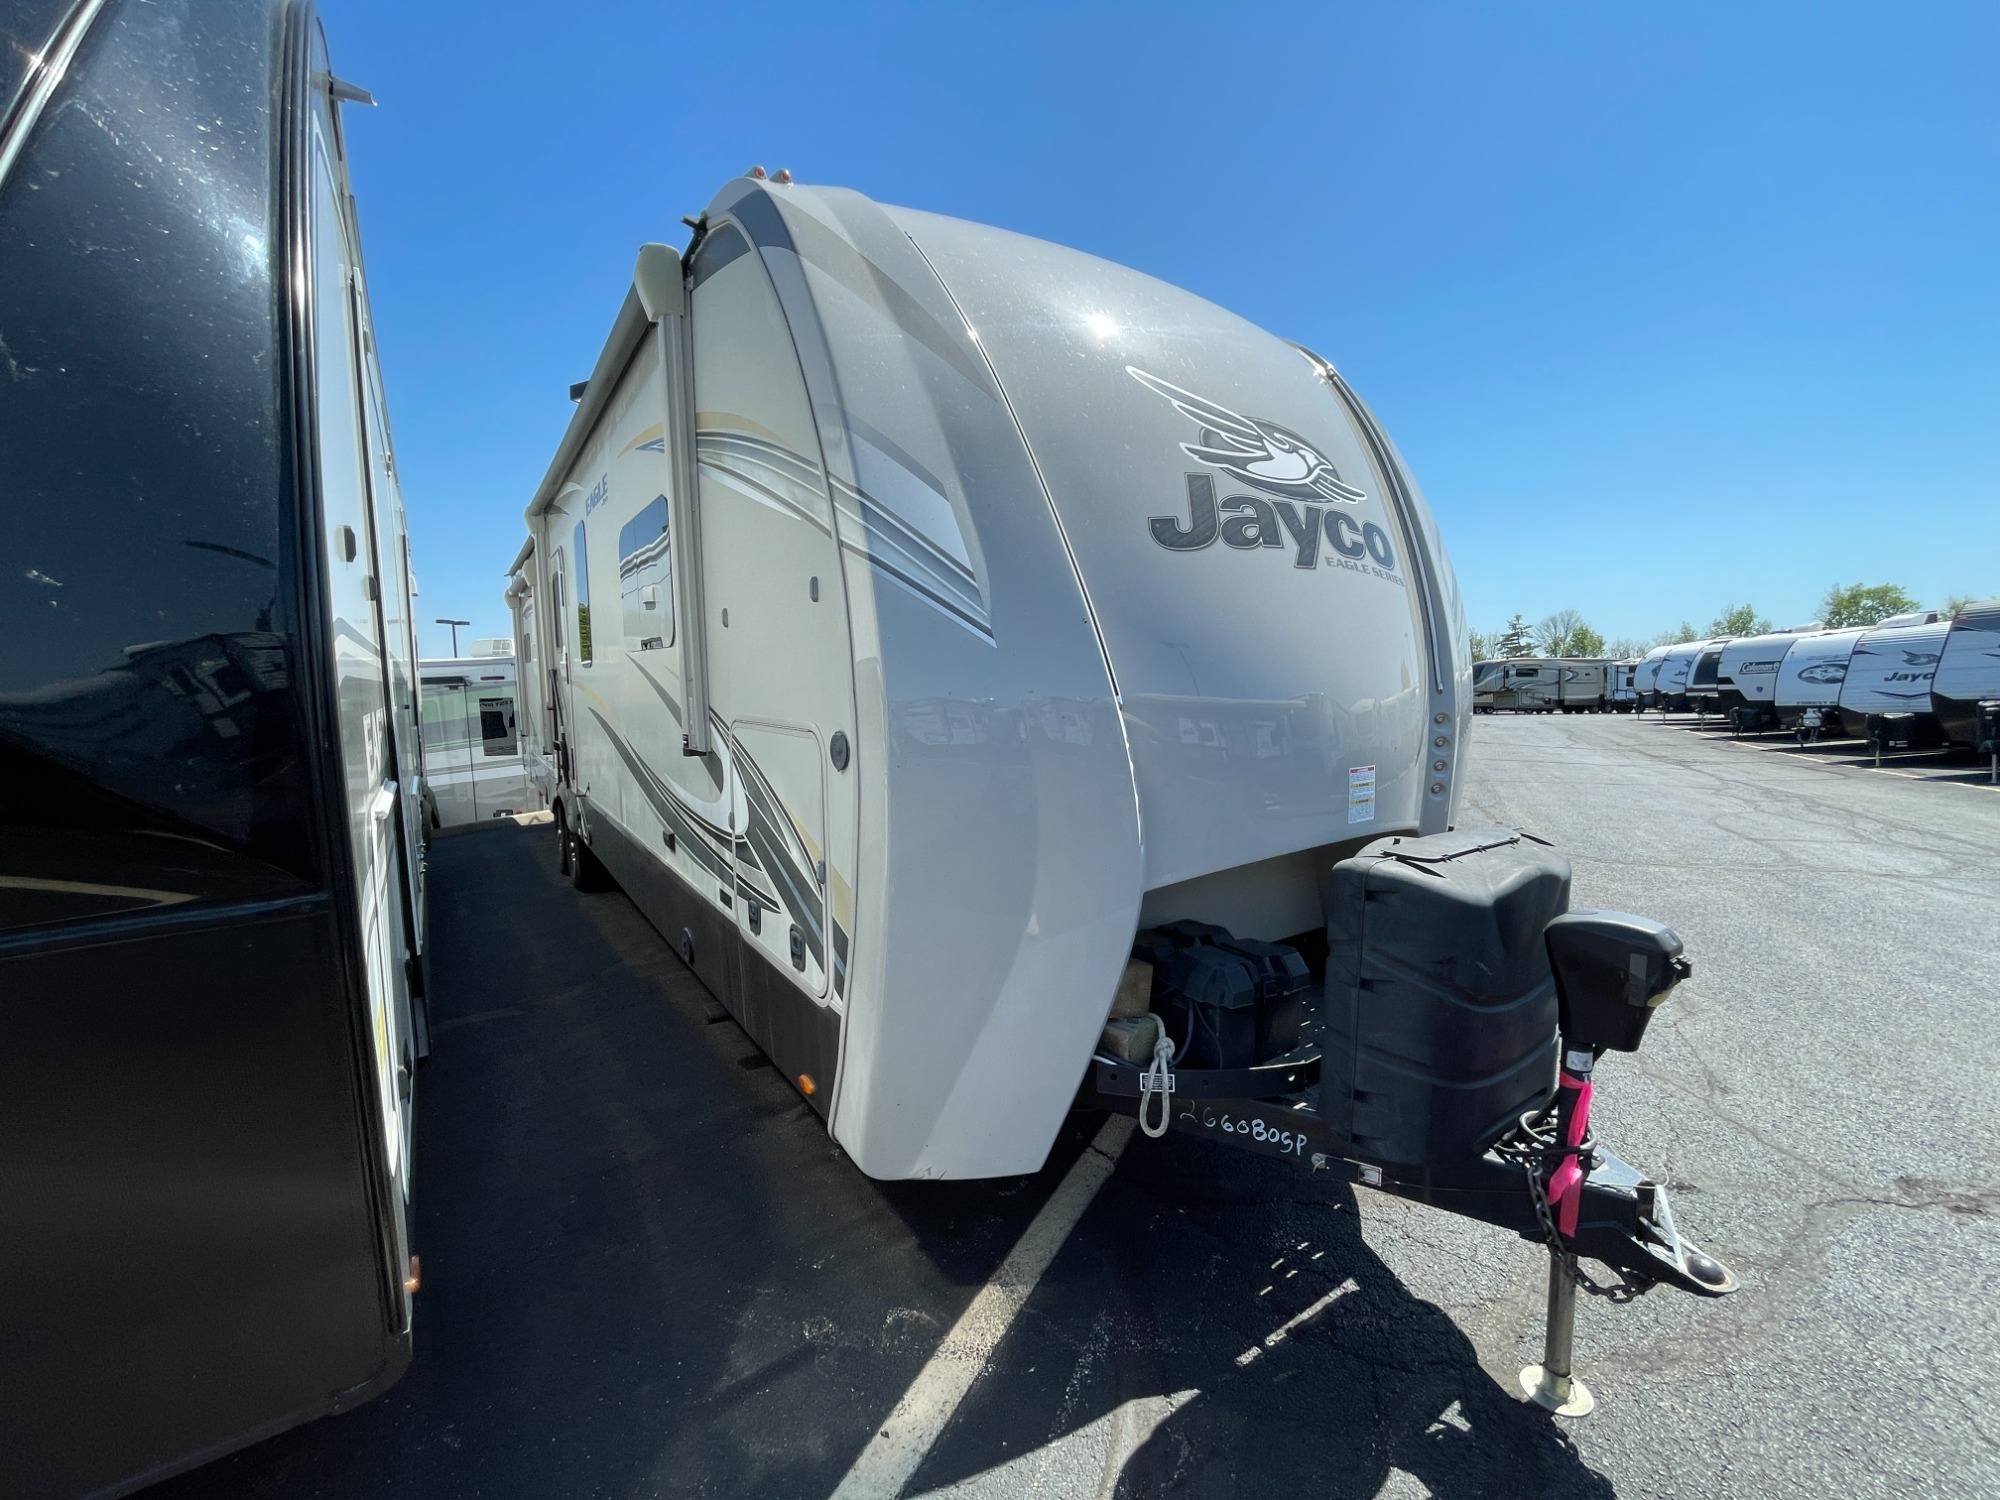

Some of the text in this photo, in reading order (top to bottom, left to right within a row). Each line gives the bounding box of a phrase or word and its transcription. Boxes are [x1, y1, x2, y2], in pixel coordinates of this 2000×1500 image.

[1147, 472, 1396, 570] Jayco
[1324, 556, 1405, 588] EAGLE SERIES
[1742, 662, 1773, 673] Coleman
[1883, 671, 1935, 683] Jayc
